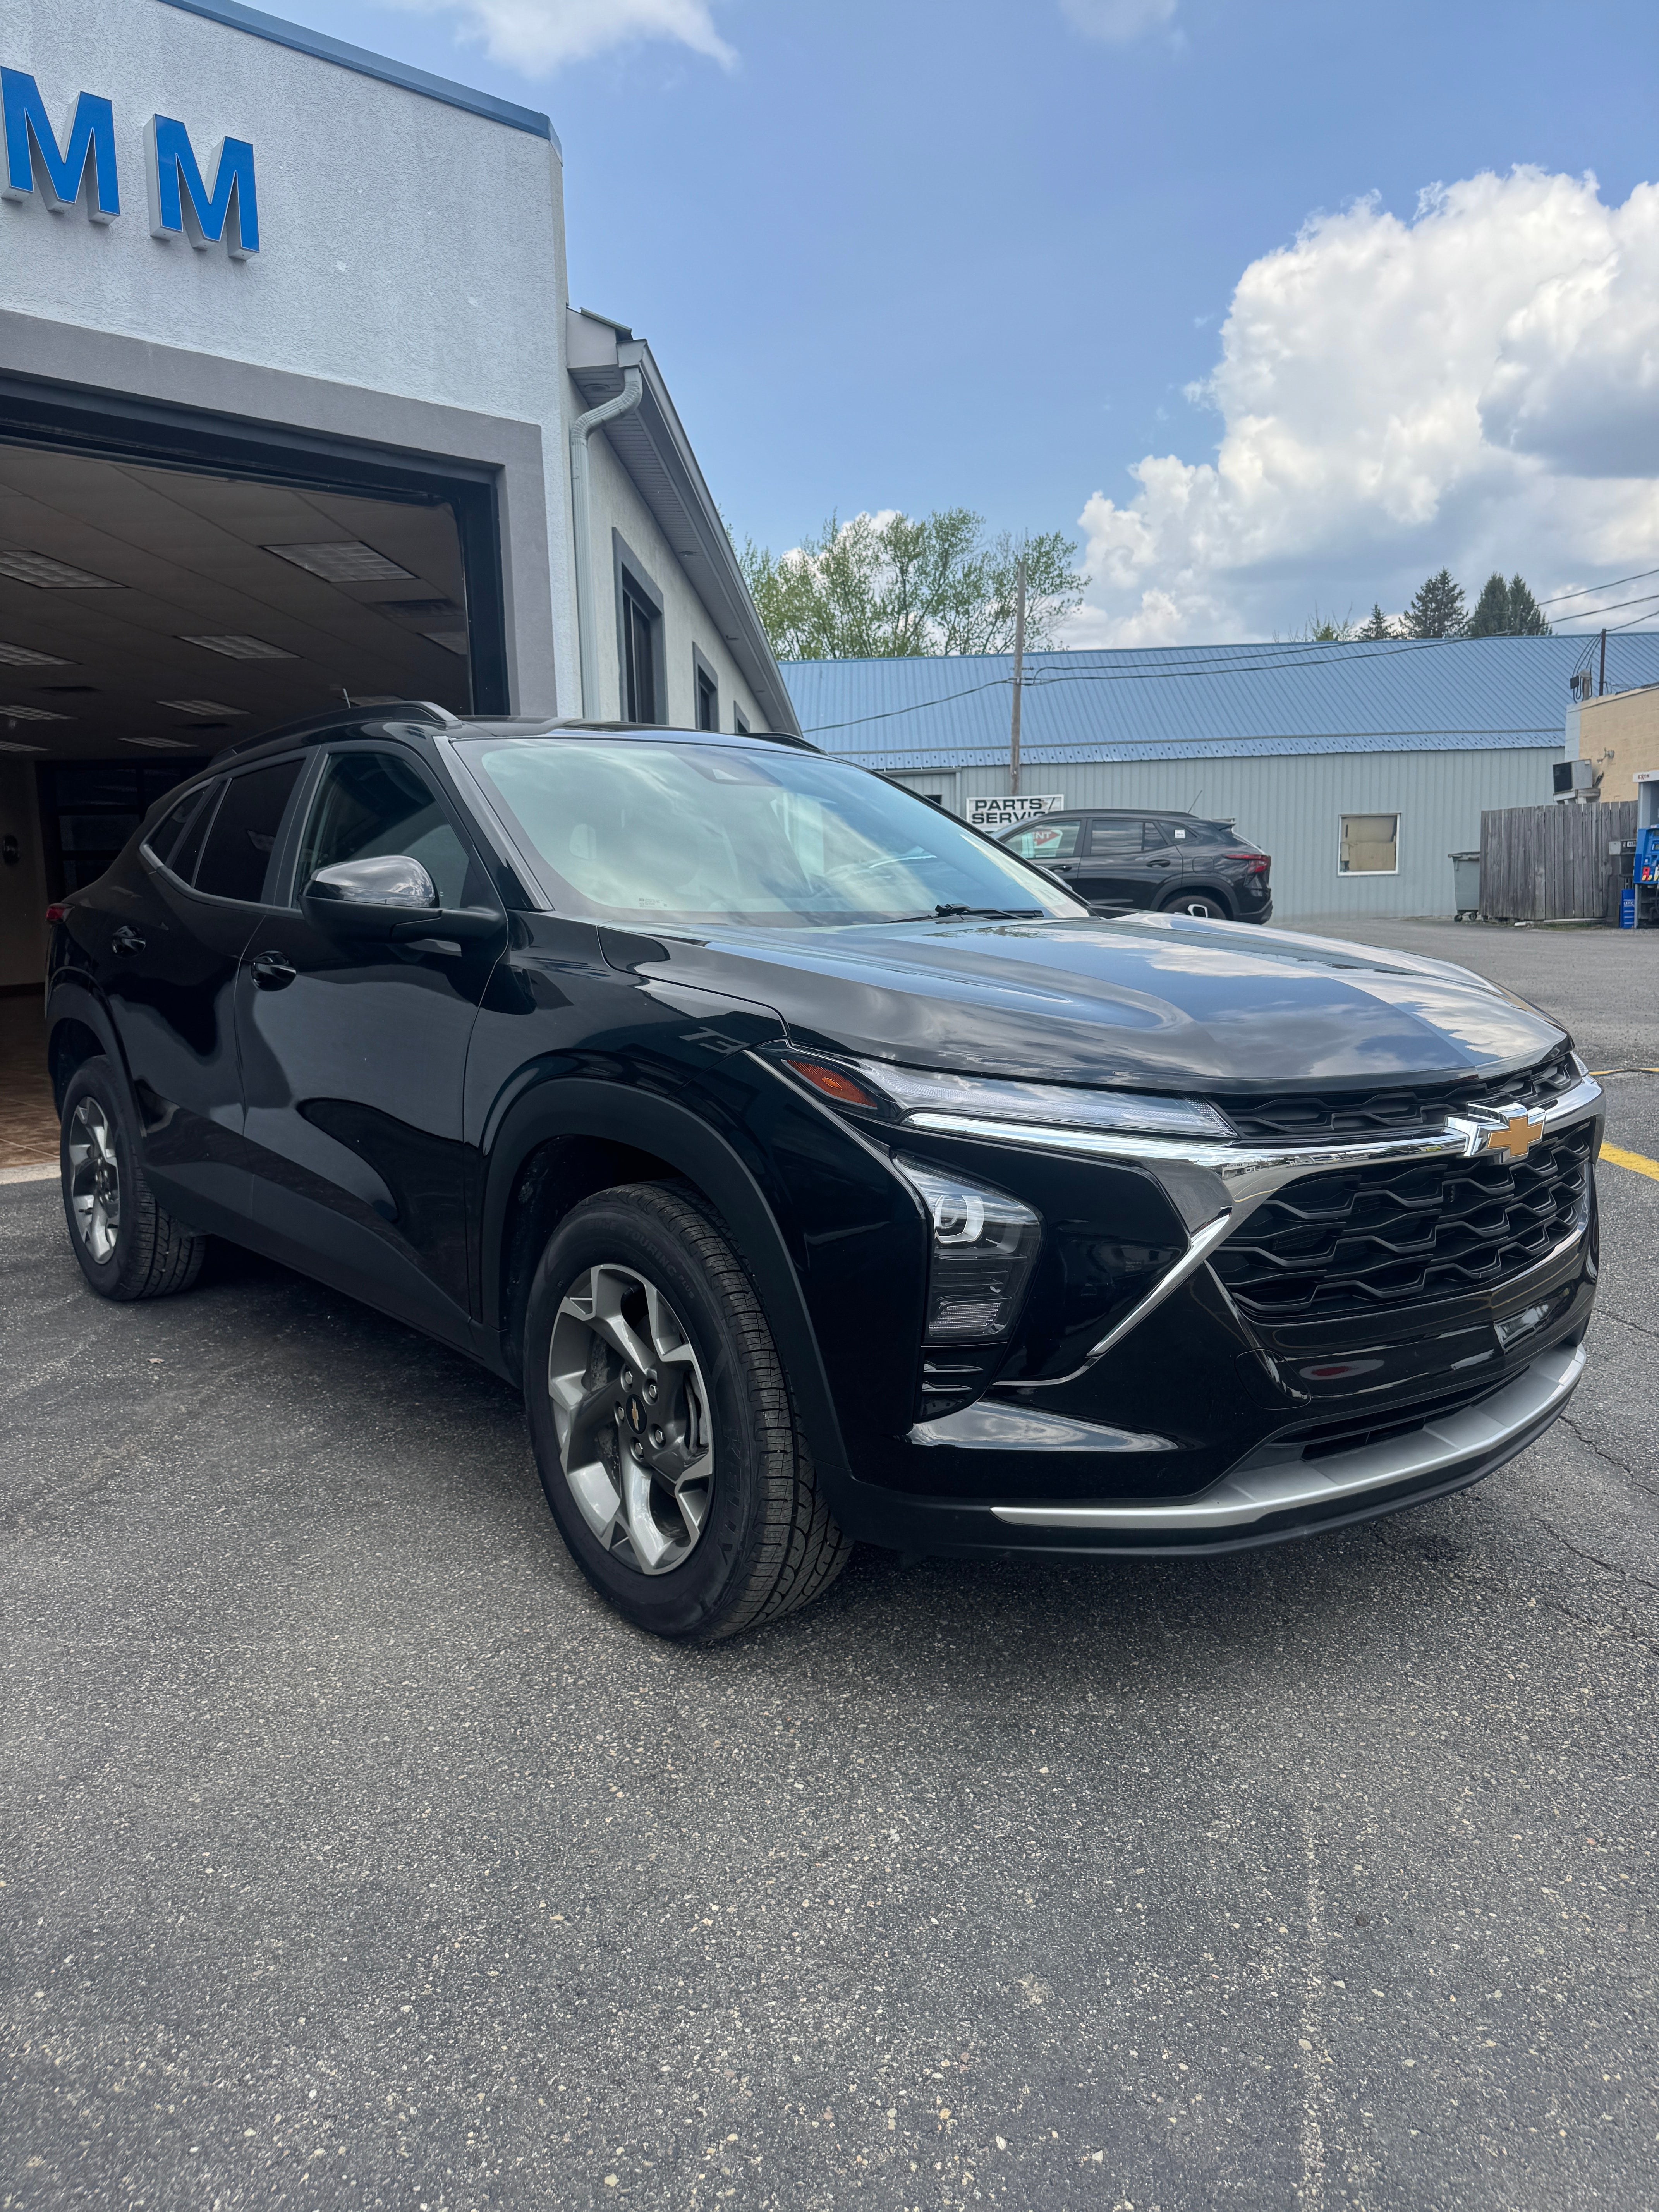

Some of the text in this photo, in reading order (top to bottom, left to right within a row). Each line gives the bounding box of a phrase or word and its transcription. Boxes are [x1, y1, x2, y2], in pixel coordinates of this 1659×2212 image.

[975, 799, 1042, 811] PARTS
[972, 811, 1046, 824] SERVI
[625, 1225, 677, 1278] TOURING
[678, 1275, 696, 1300] PLUS
